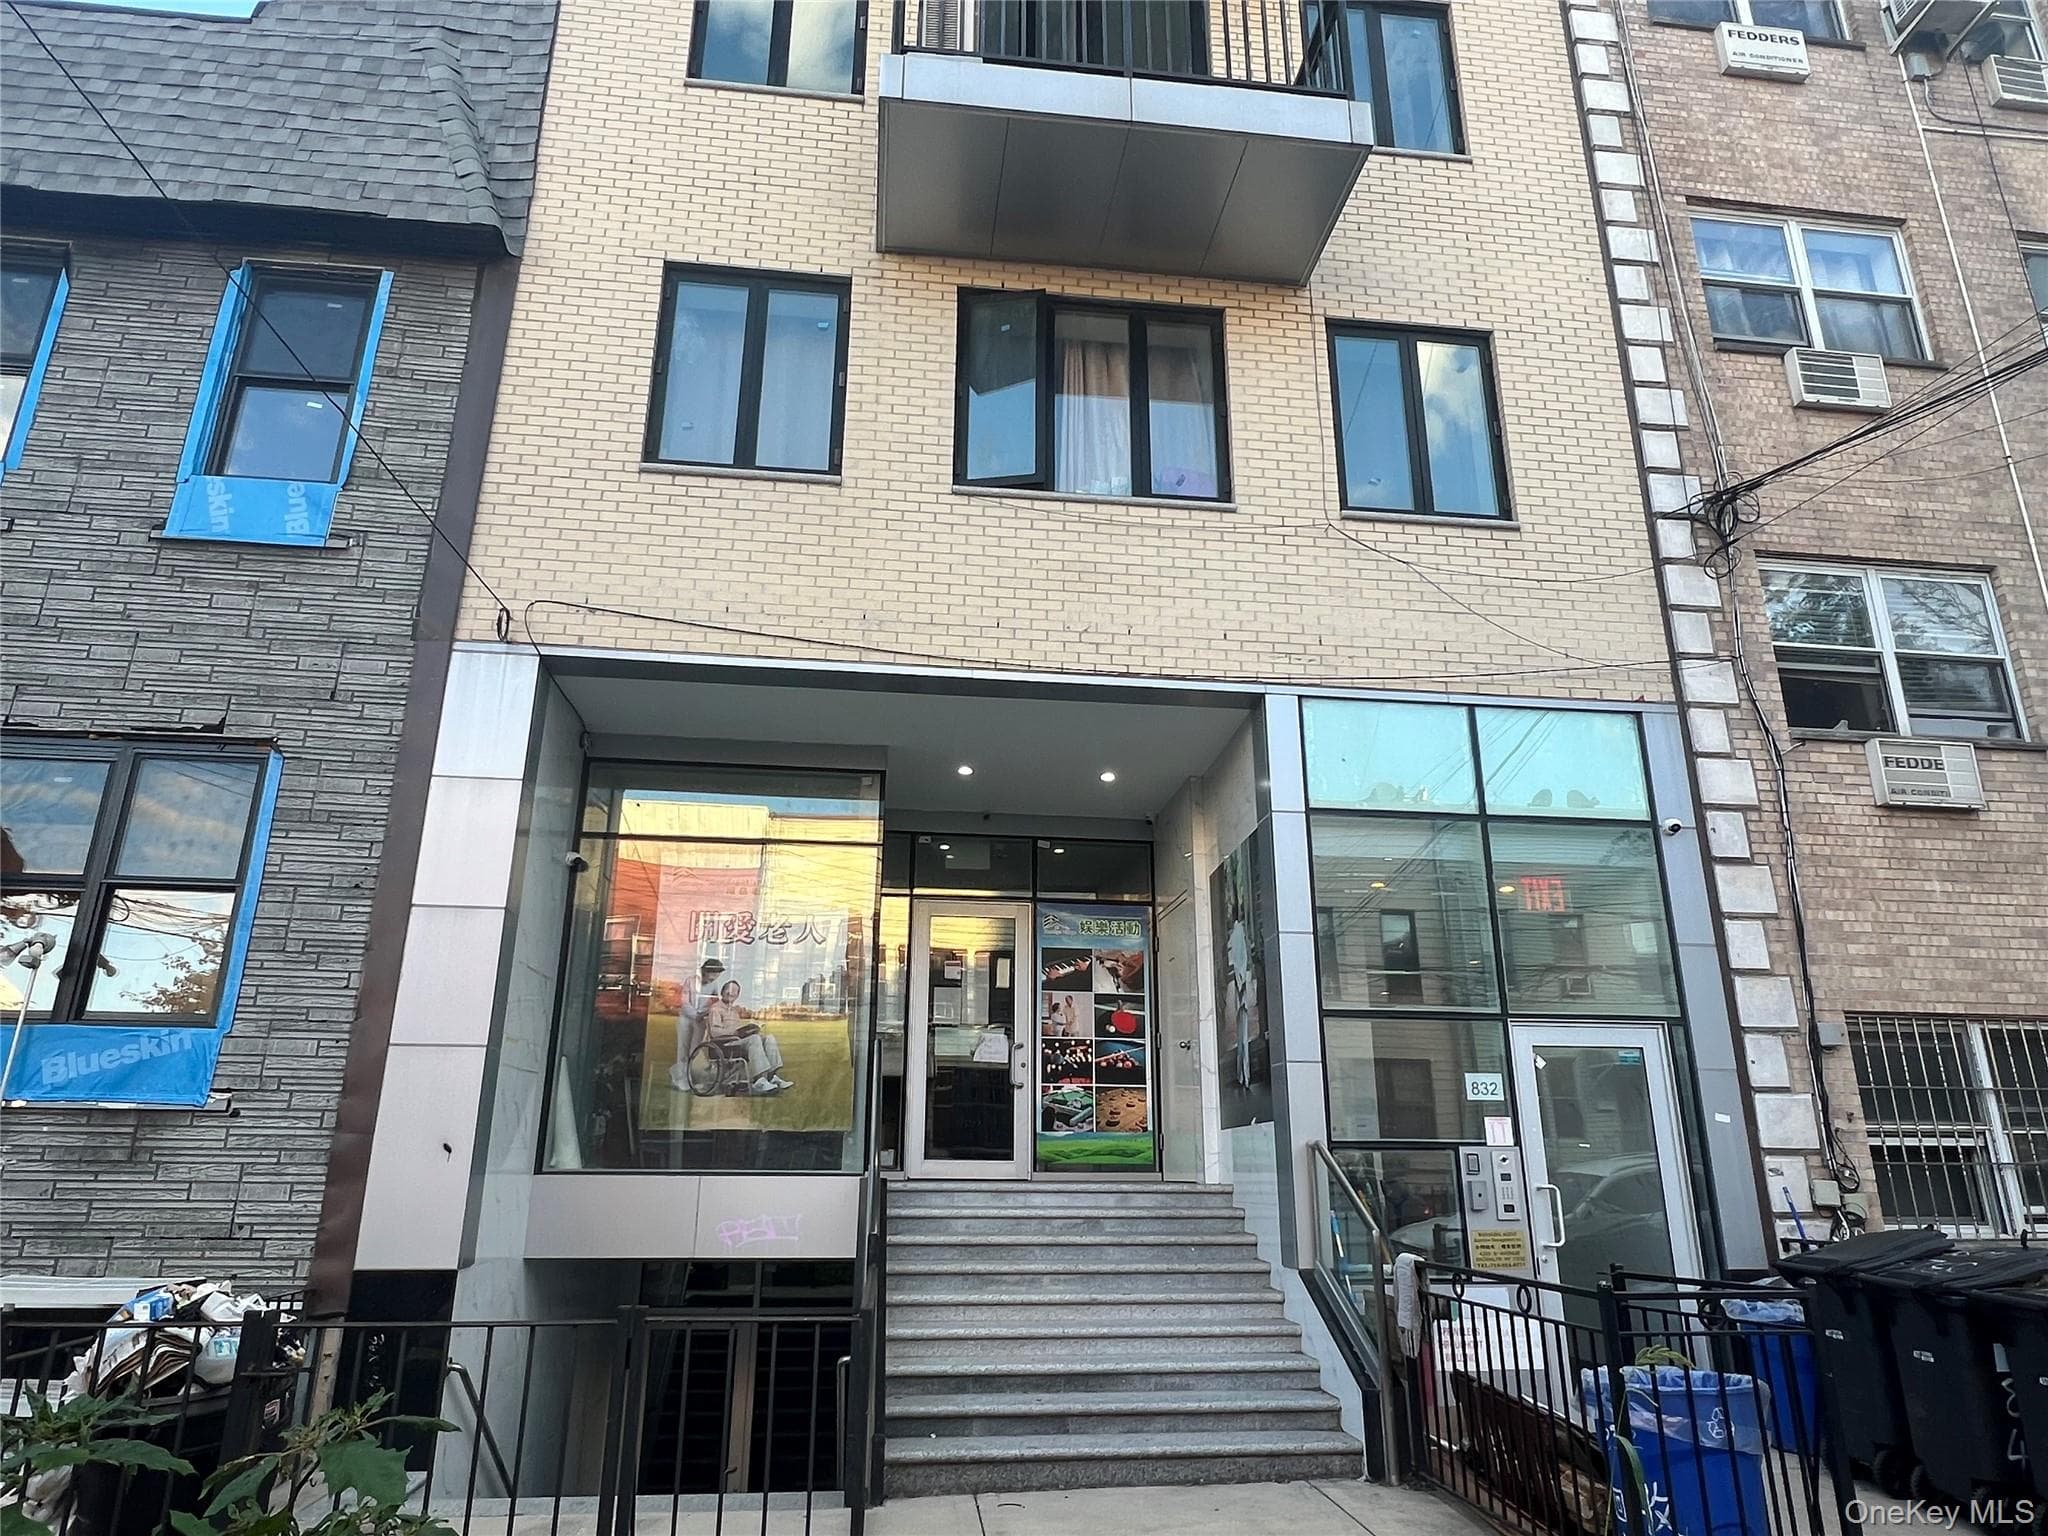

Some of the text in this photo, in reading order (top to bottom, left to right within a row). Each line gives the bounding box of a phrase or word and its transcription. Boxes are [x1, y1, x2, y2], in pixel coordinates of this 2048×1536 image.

[1727, 28, 1800, 46] FEDDERS
[1732, 50, 1804, 65] AIR CONDITIONER
[1884, 756, 1944, 771] FEDDE
[41, 1029, 192, 1085] Blueskin
[1470, 1081, 1499, 1096] 832
